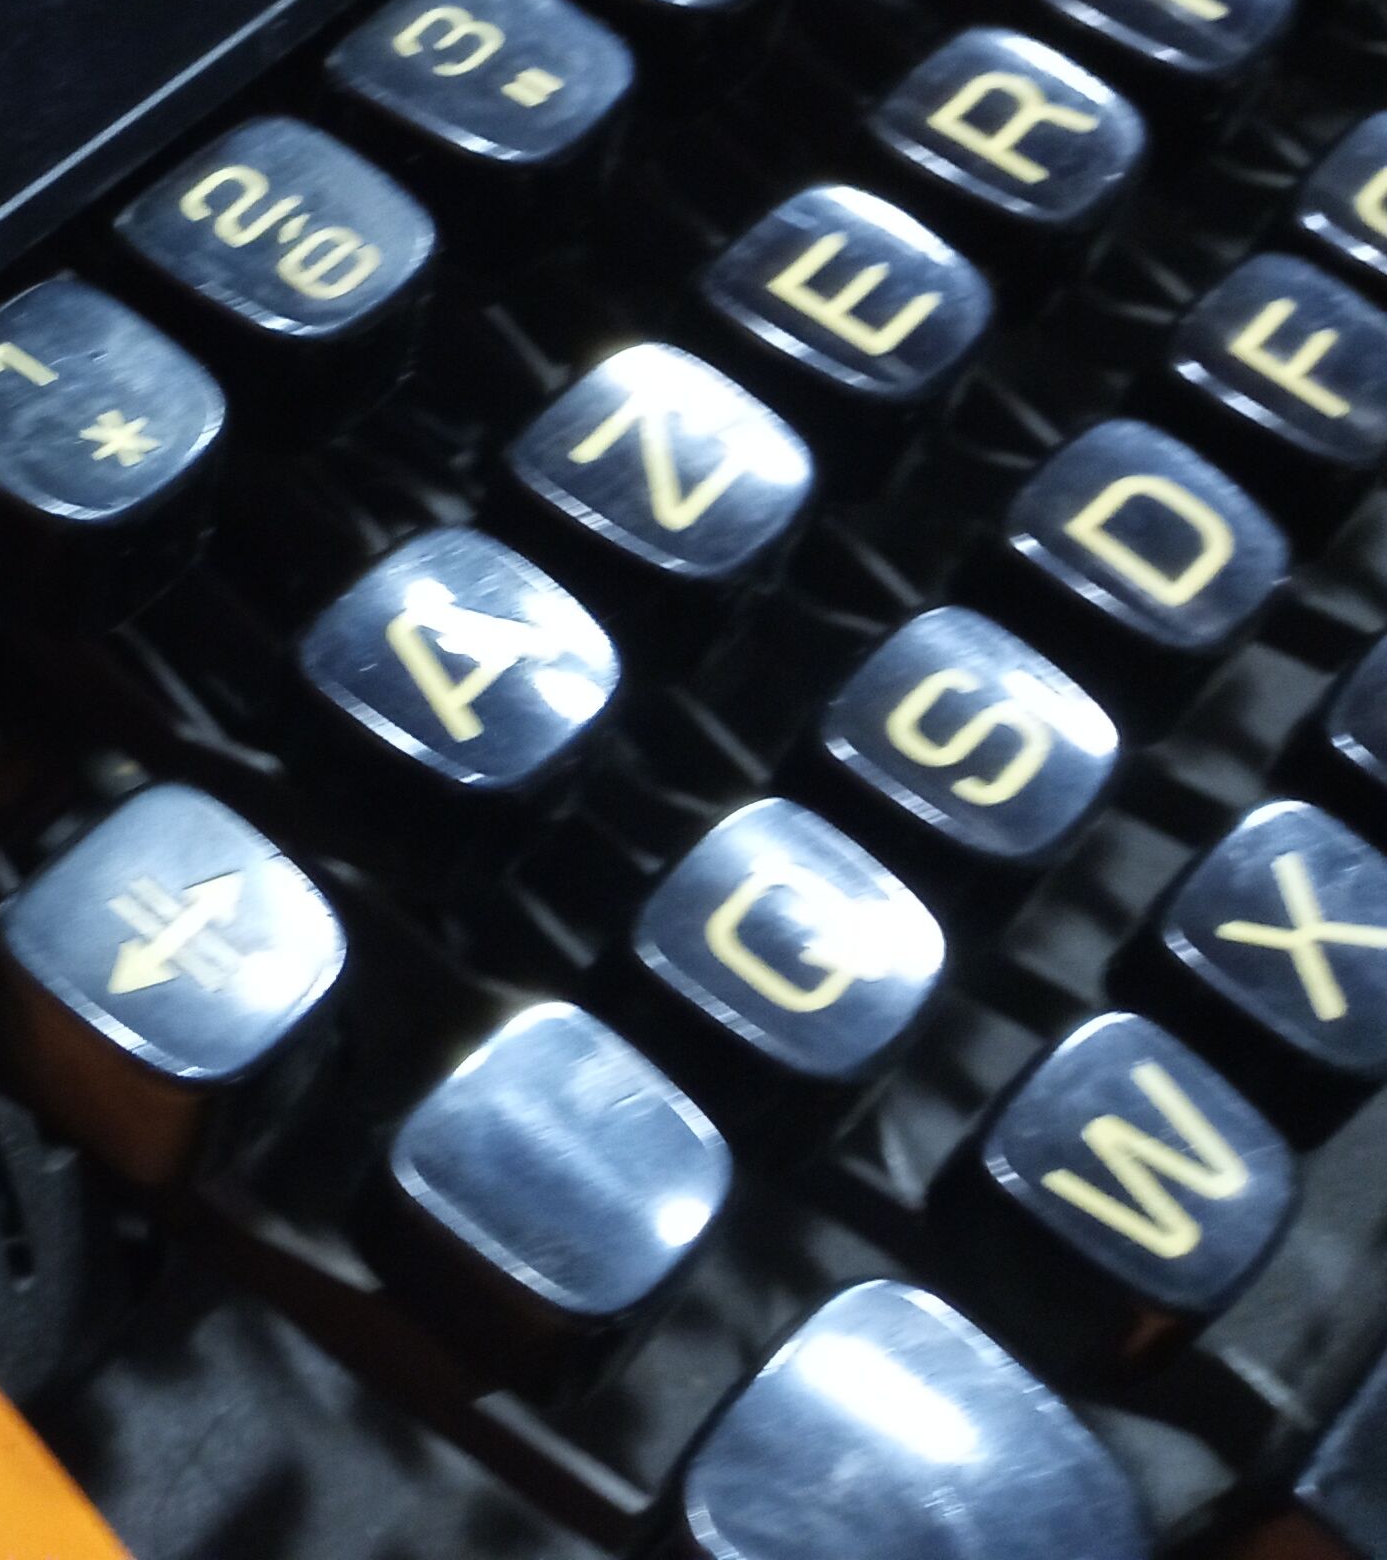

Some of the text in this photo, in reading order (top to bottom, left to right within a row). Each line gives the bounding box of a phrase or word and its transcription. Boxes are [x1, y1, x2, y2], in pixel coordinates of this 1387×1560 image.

[391, 5, 506, 77] 3
[927, 71, 1102, 185] R
[179, 164, 305, 248] 2
[765, 230, 945, 358] E
[1228, 296, 1353, 420] F
[566, 385, 759, 532] Z
[1063, 474, 1235, 608] D
[385, 600, 539, 743] A
[885, 668, 1053, 807] S
[704, 860, 877, 1013] Q
[1213, 850, 1387, 1021] X
[1039, 1060, 1250, 1260] W
